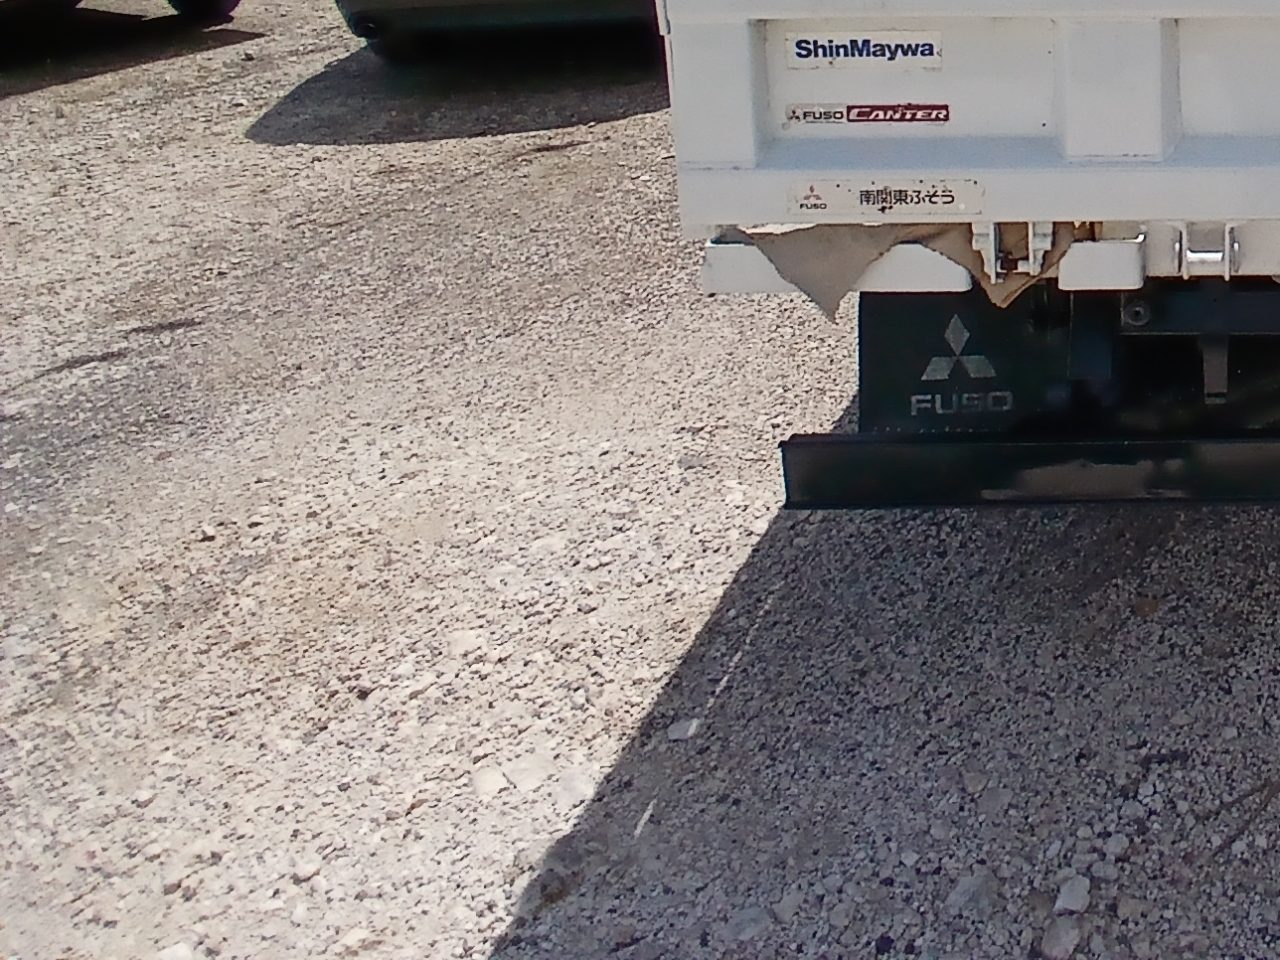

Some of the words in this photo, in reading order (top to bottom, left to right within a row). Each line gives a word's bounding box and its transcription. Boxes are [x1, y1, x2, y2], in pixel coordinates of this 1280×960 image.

[795, 39, 934, 61] ShinMaywa
[803, 111, 844, 120] FUSO
[849, 108, 947, 120] CANTER
[859, 190, 955, 205] 南関東ふそう
[911, 391, 1013, 416] FUSO
